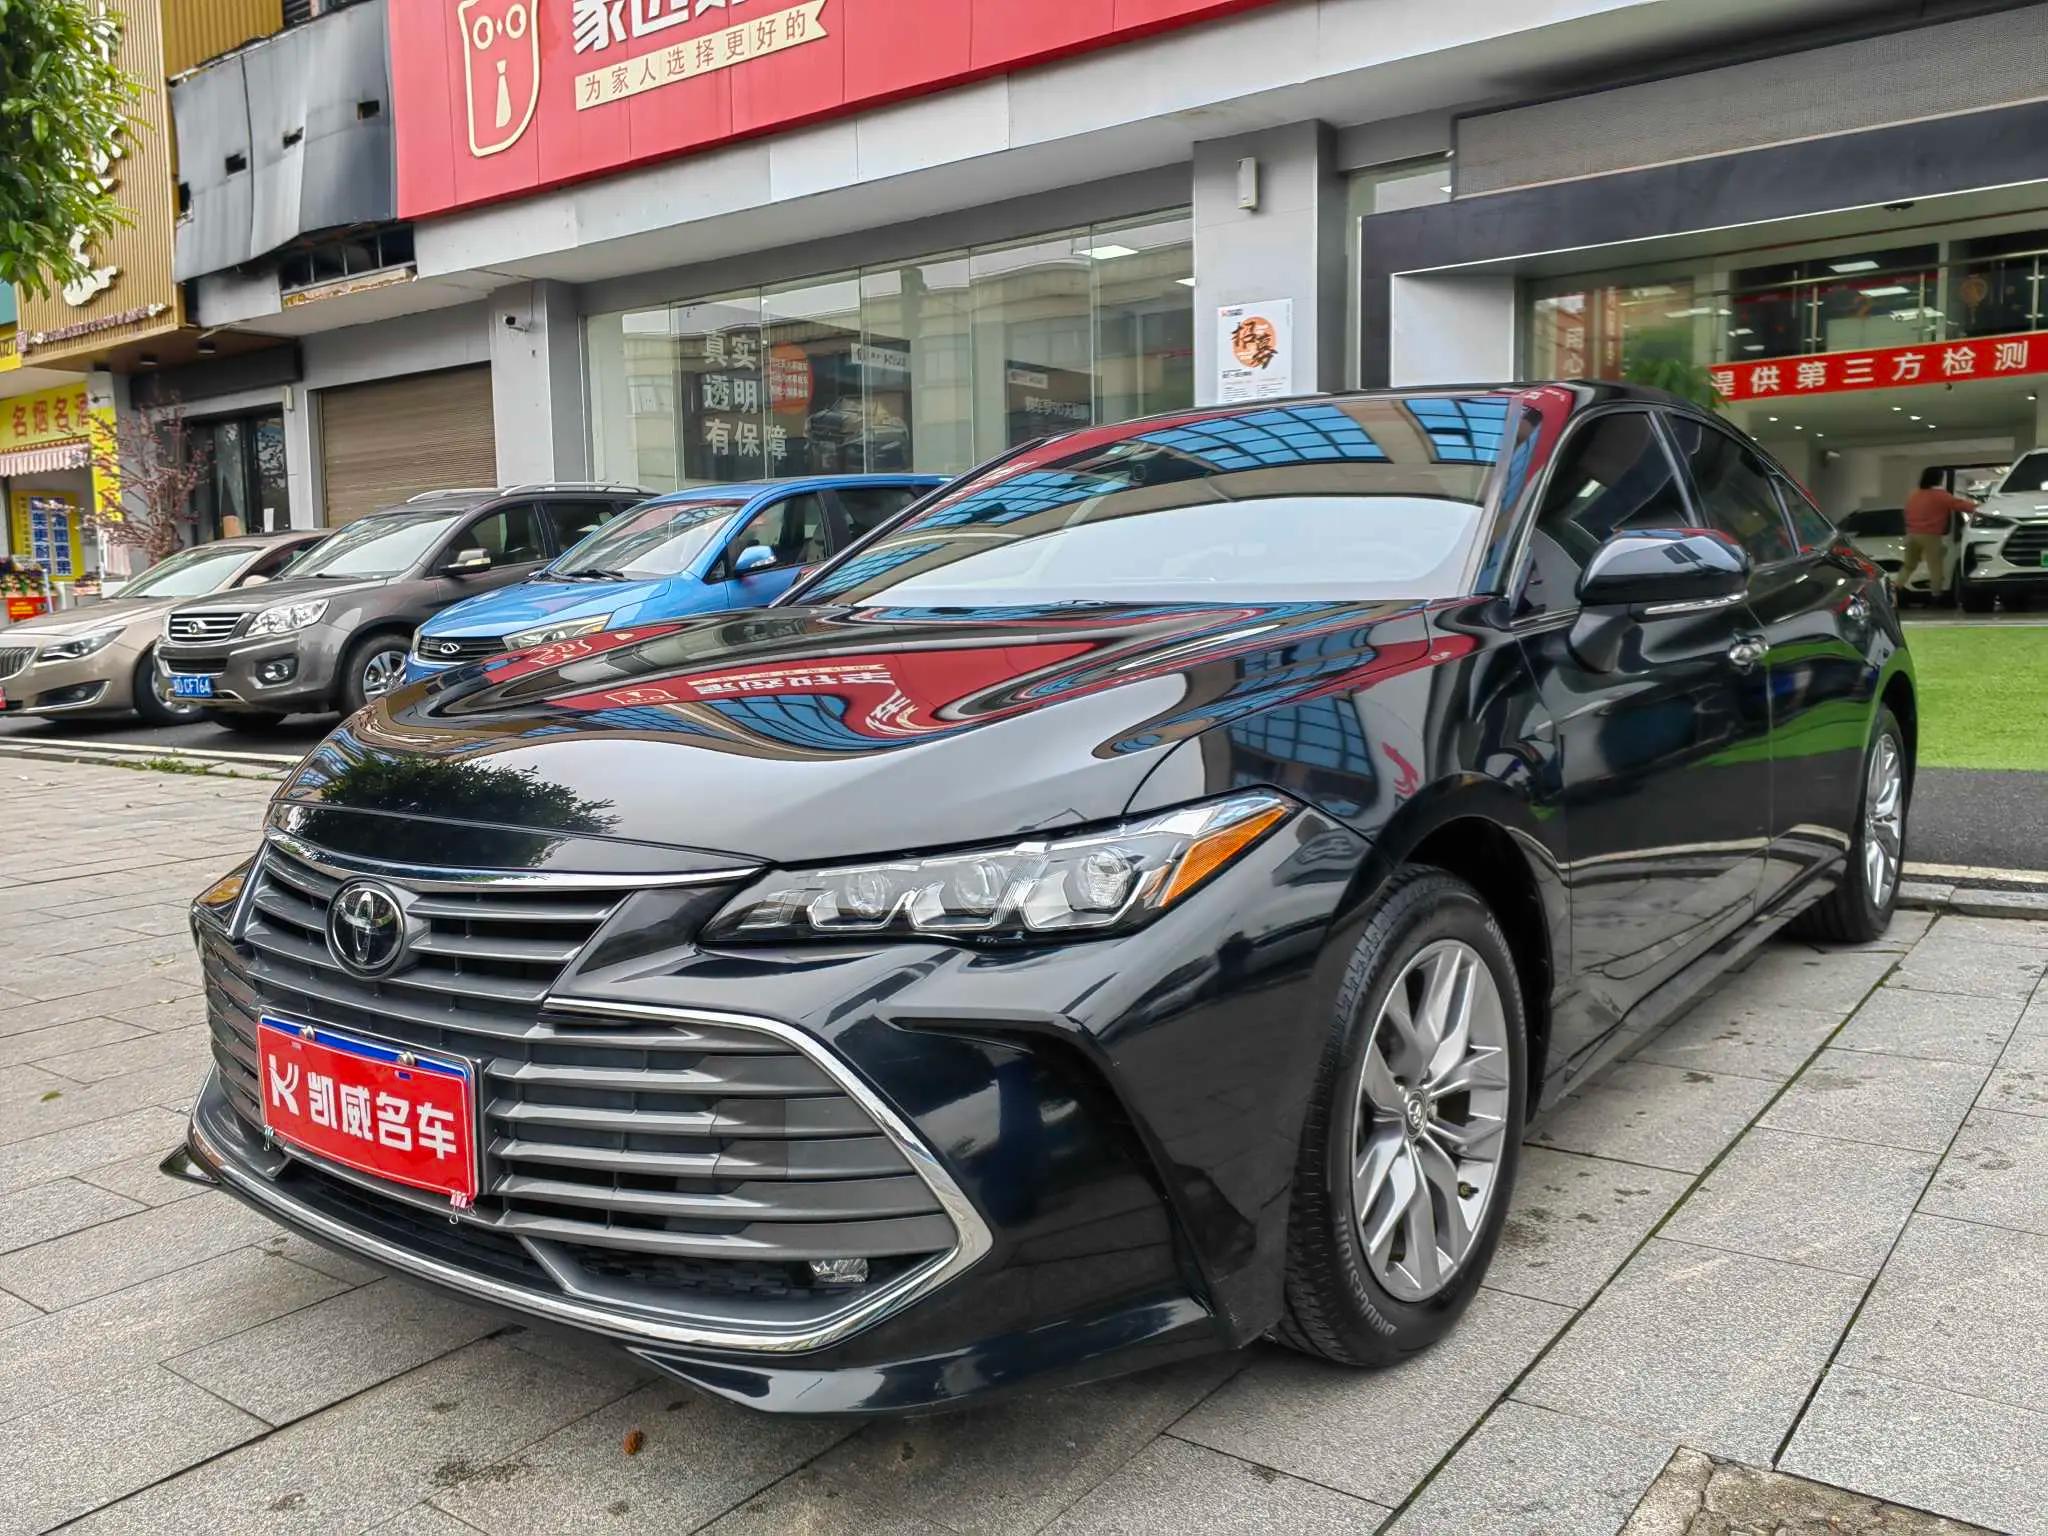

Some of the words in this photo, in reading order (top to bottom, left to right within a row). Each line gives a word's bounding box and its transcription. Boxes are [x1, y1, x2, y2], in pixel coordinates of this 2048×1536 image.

[584, 11, 806, 102] 为家人选择更好的
[701, 332, 757, 371] 真实
[703, 374, 758, 415] 透明
[705, 418, 788, 461] 有保障
[308, 1072, 457, 1160] 凯威名车
